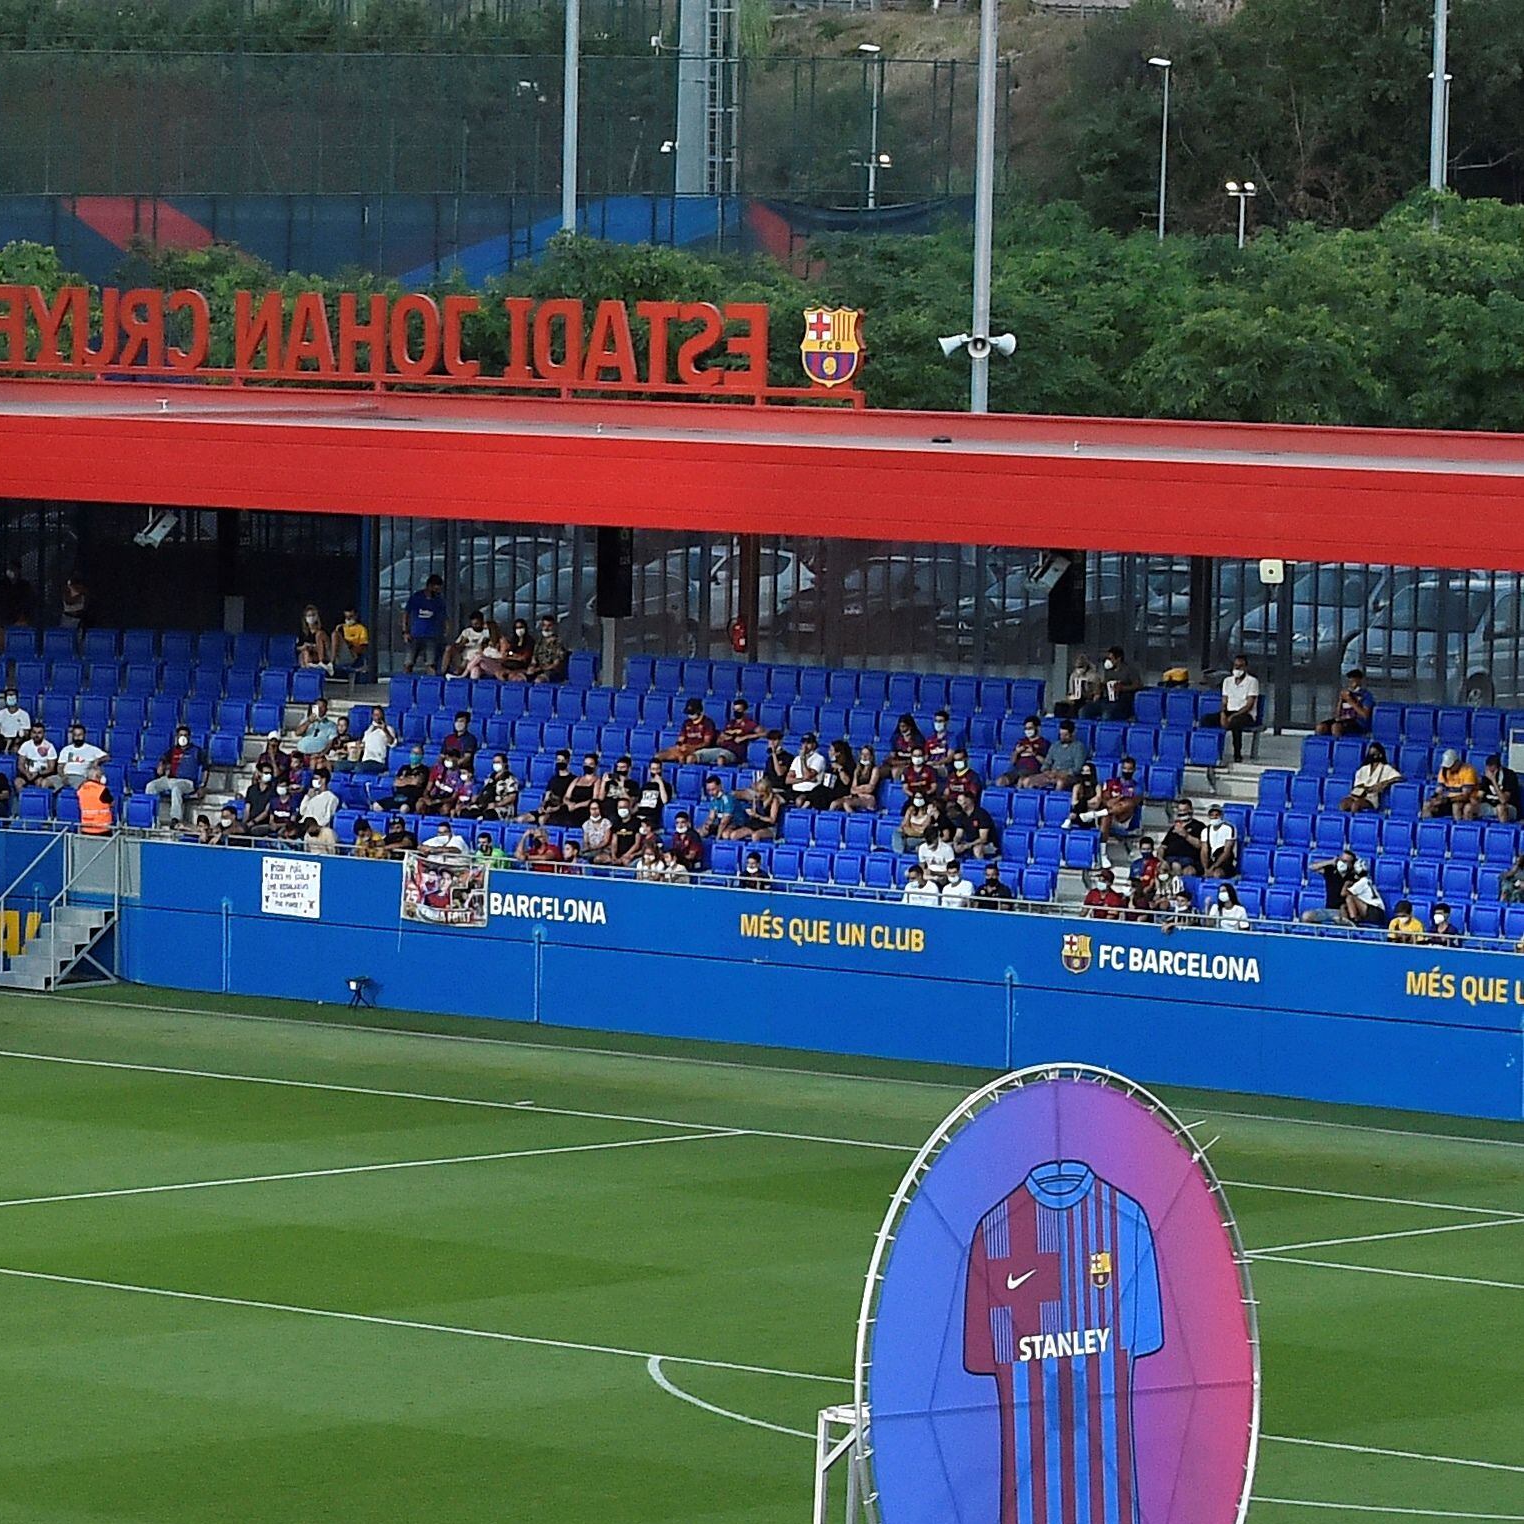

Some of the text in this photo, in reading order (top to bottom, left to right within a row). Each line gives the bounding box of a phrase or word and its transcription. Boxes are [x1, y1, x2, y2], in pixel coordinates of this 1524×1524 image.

[740, 912, 925, 953] MÉS QUE UN CLUB
[1098, 944, 1261, 983] FC BARCELONA
[1406, 965, 1456, 999] MÉS
[1461, 975, 1509, 1006] QUE
[1018, 1327, 1110, 1362] STANLEY
